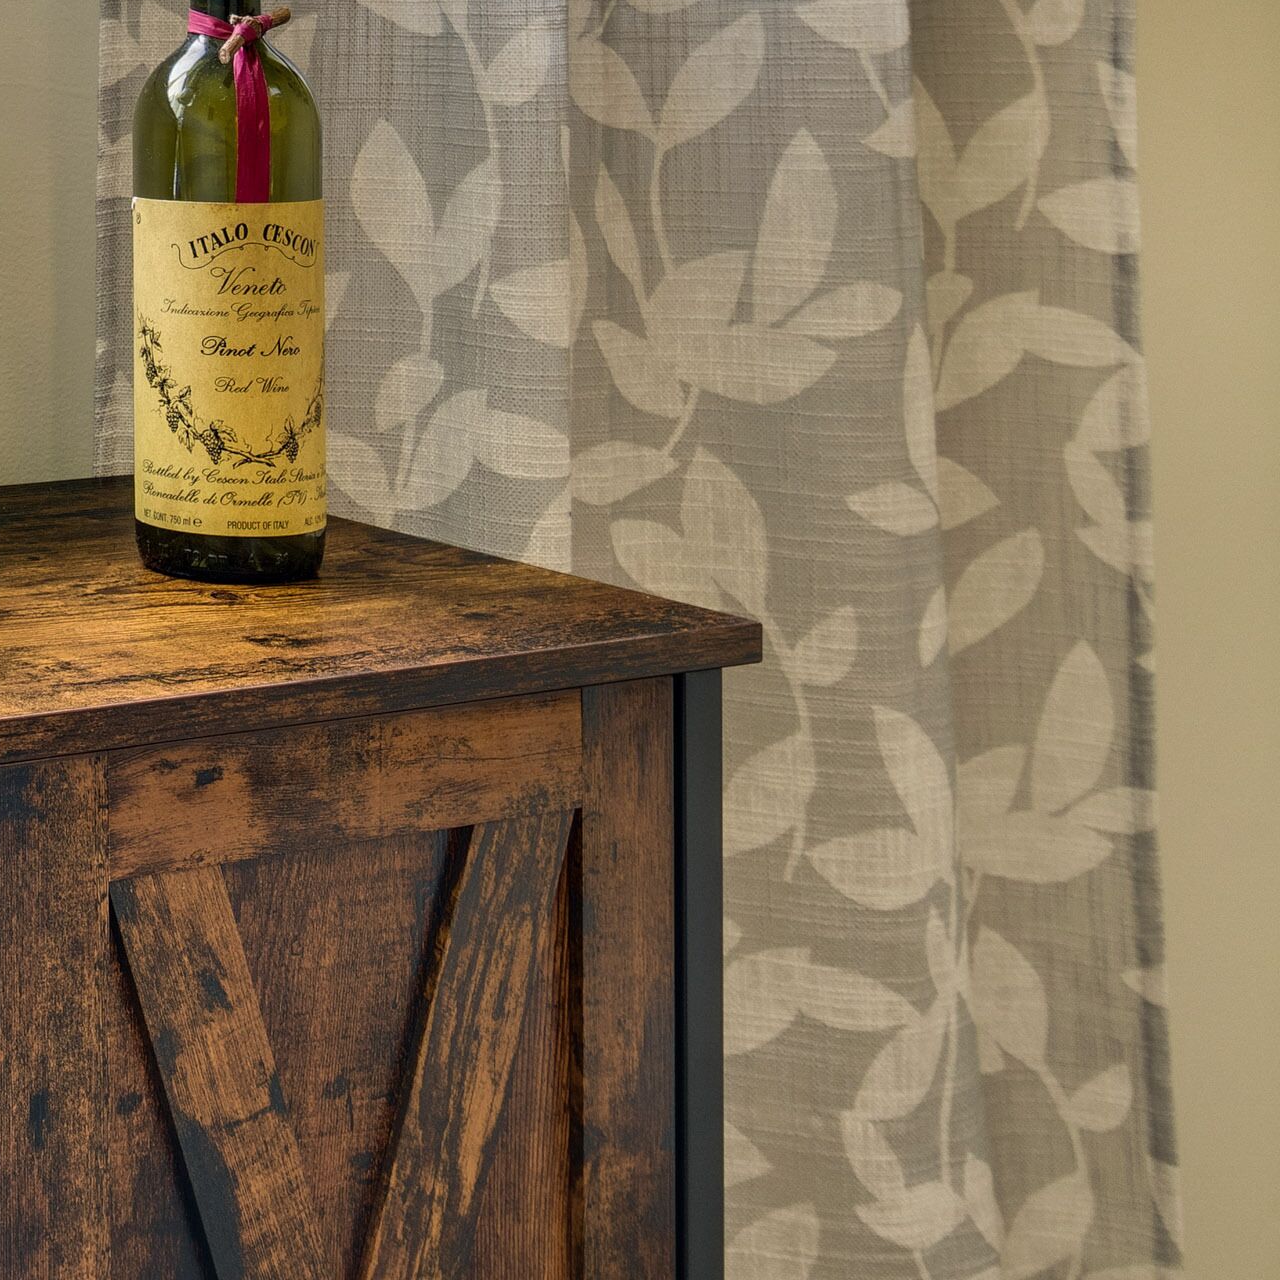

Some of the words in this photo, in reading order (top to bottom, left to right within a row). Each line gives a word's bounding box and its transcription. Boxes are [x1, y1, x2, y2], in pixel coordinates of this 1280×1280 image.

[188, 222, 249, 259] ITALO
[262, 223, 317, 257] CESCON
[210, 266, 287, 296] Veneto
[160, 298, 230, 317] Indicazione
[230, 302, 294, 322] Geografica
[200, 335, 256, 357] Pinot
[260, 335, 301, 357] Nero
[214, 376, 253, 393] Red
[255, 376, 290, 393] Wine
[142, 459, 183, 480] Bottled
[183, 467, 200, 486] by
[201, 467, 249, 485] Cescon
[252, 469, 288, 485] Italo
[142, 480, 200, 504] Roncadelle
[202, 492, 218, 505] di
[220, 491, 275, 507] Ormelle
[169, 514, 182, 525] 750
[227, 520, 261, 530] PRODUCT
[262, 520, 272, 530] OF
[273, 519, 290, 530] ITALY
